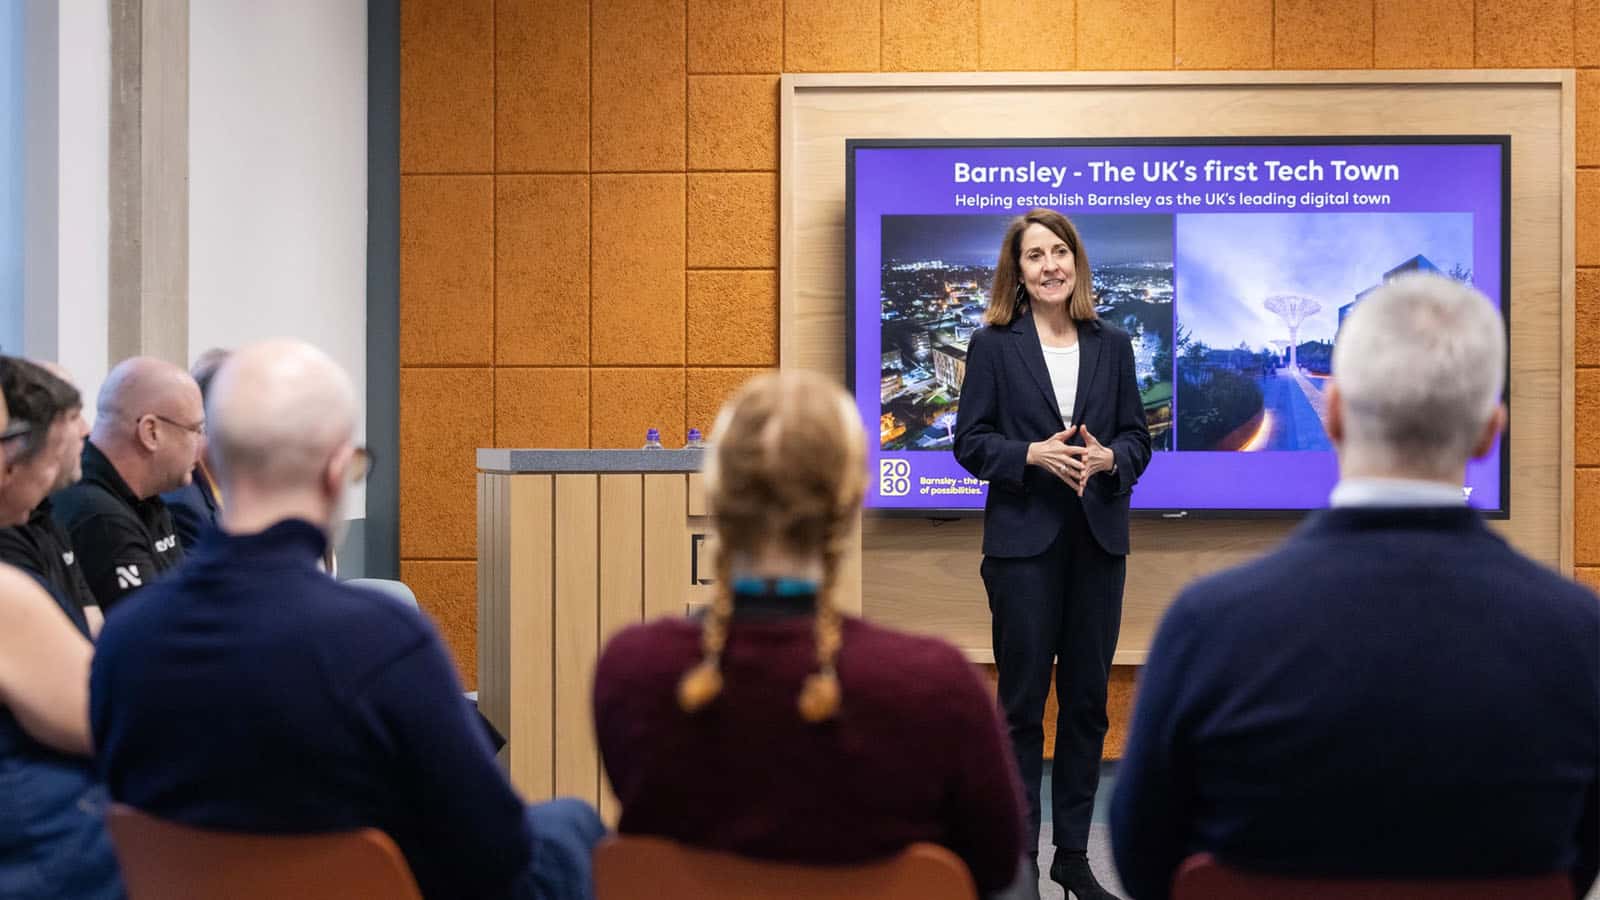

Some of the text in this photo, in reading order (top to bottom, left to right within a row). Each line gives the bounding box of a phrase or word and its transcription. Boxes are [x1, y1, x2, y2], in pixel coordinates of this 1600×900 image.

[954, 160, 1067, 188] Barnsley
[1087, 160, 1137, 182] The
[1203, 159, 1259, 182] first
[1263, 159, 1324, 182] Tech
[1330, 160, 1400, 182] Town
[955, 193, 1013, 209] Helping
[1016, 193, 1084, 207] establish
[1087, 192, 1153, 209] Barnsley
[1155, 195, 1173, 206] as
[1175, 193, 1202, 206] the
[1239, 191, 1297, 208] leading
[1300, 191, 1349, 209] digital
[1352, 193, 1391, 206] town
[882, 461, 909, 477] 20
[882, 478, 909, 494] 30
[919, 476, 957, 487] Barnsley
[963, 477, 979, 485] the
[919, 486, 983, 497] of possibilities.
